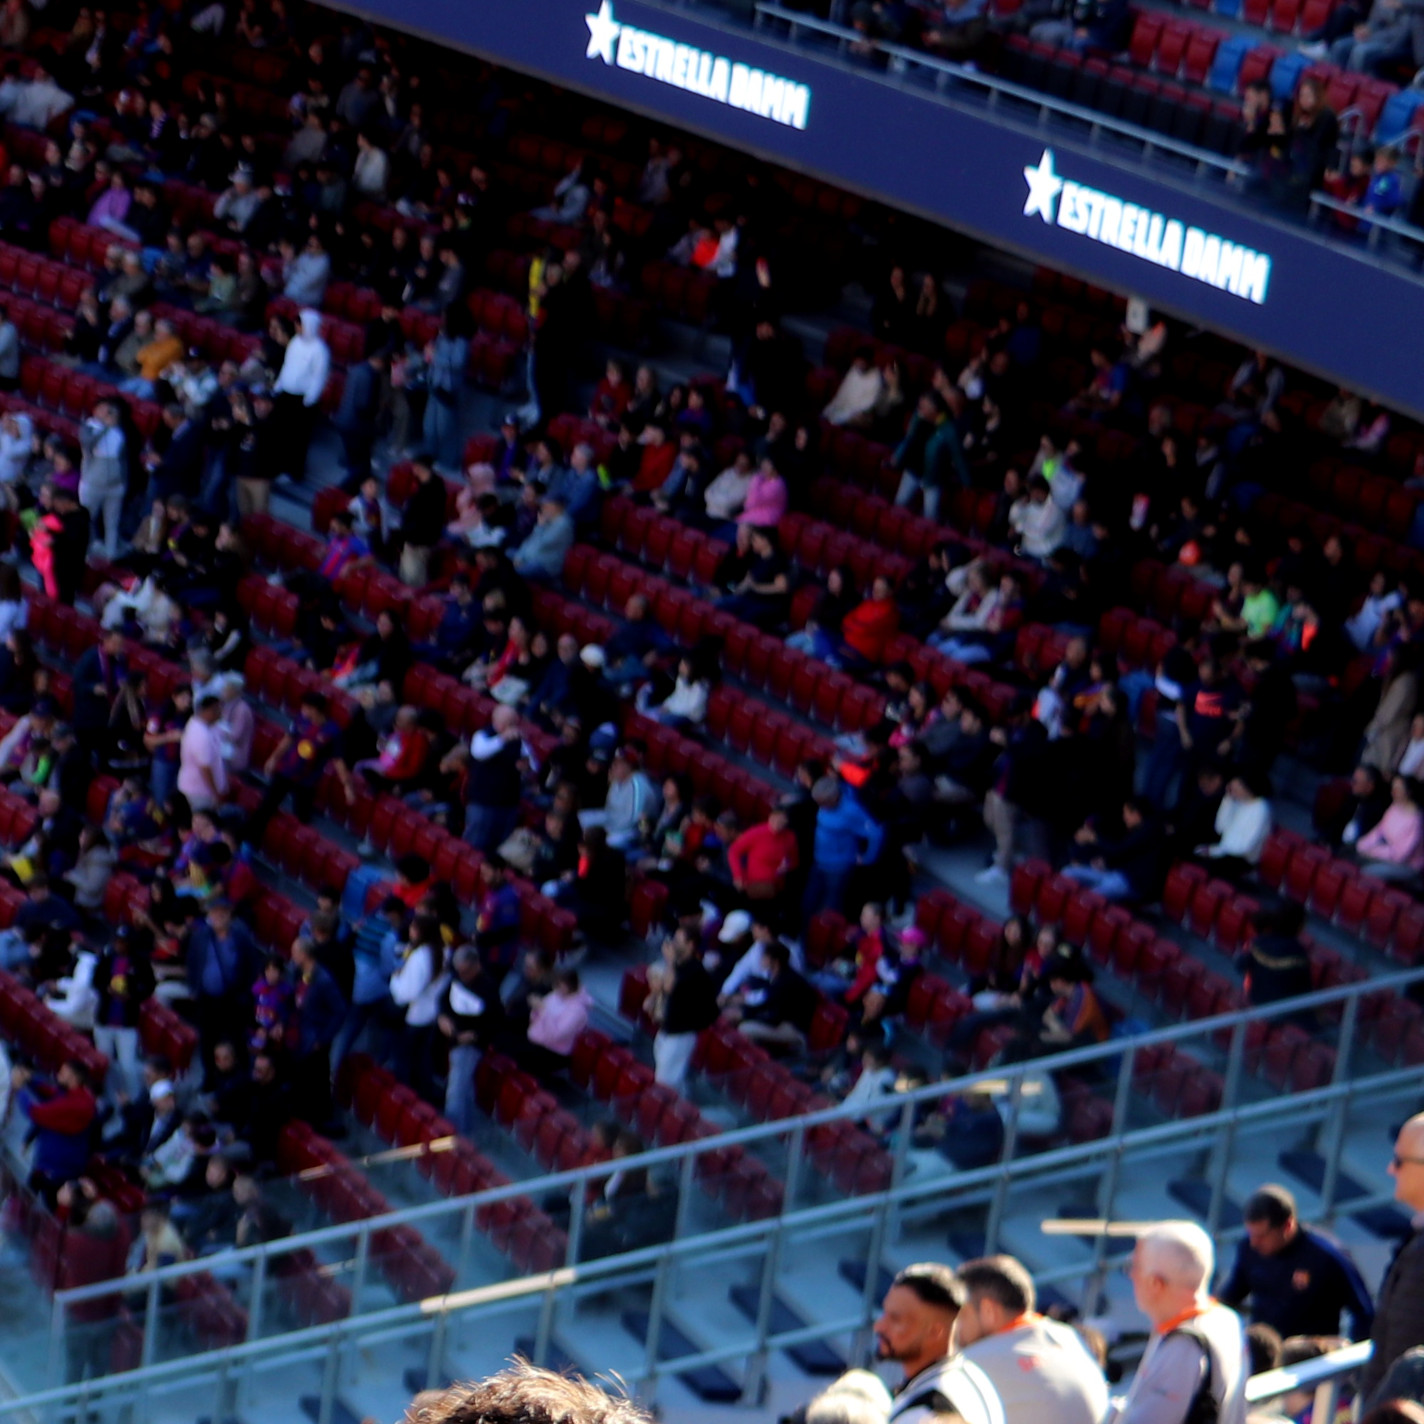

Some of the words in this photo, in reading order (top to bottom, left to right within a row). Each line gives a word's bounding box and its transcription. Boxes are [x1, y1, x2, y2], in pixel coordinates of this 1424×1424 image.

[616, 23, 732, 104] ESTRELLA
[728, 61, 812, 131] DAMM
[1056, 179, 1185, 273] ESTRELLA
[1180, 225, 1272, 306] DAMM
